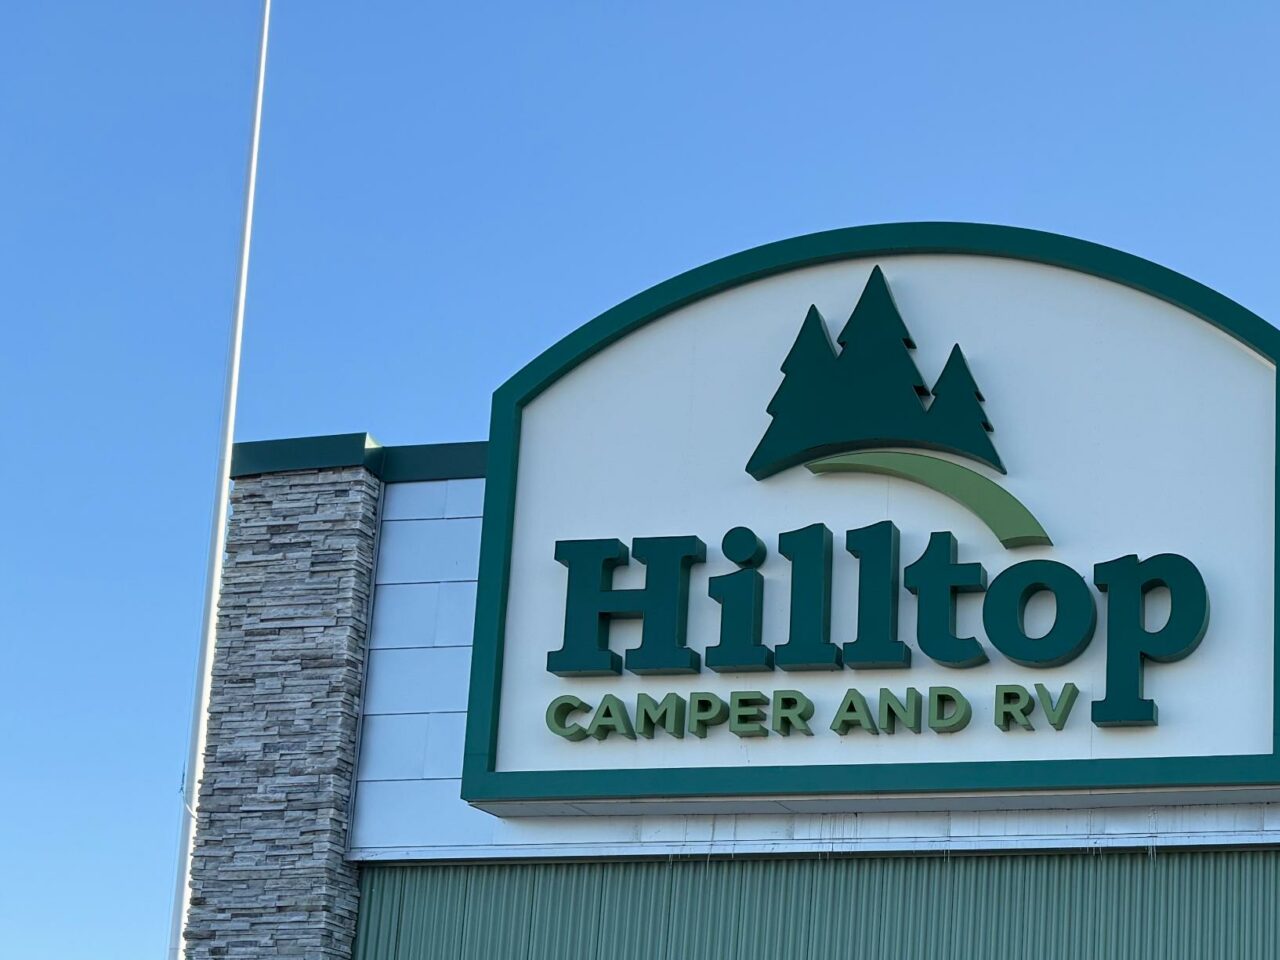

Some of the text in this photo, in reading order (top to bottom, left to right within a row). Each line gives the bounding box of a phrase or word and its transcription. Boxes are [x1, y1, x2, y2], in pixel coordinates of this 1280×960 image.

[547, 520, 1210, 727] Hilltop
[545, 682, 1080, 742] CAMPER AND RV
